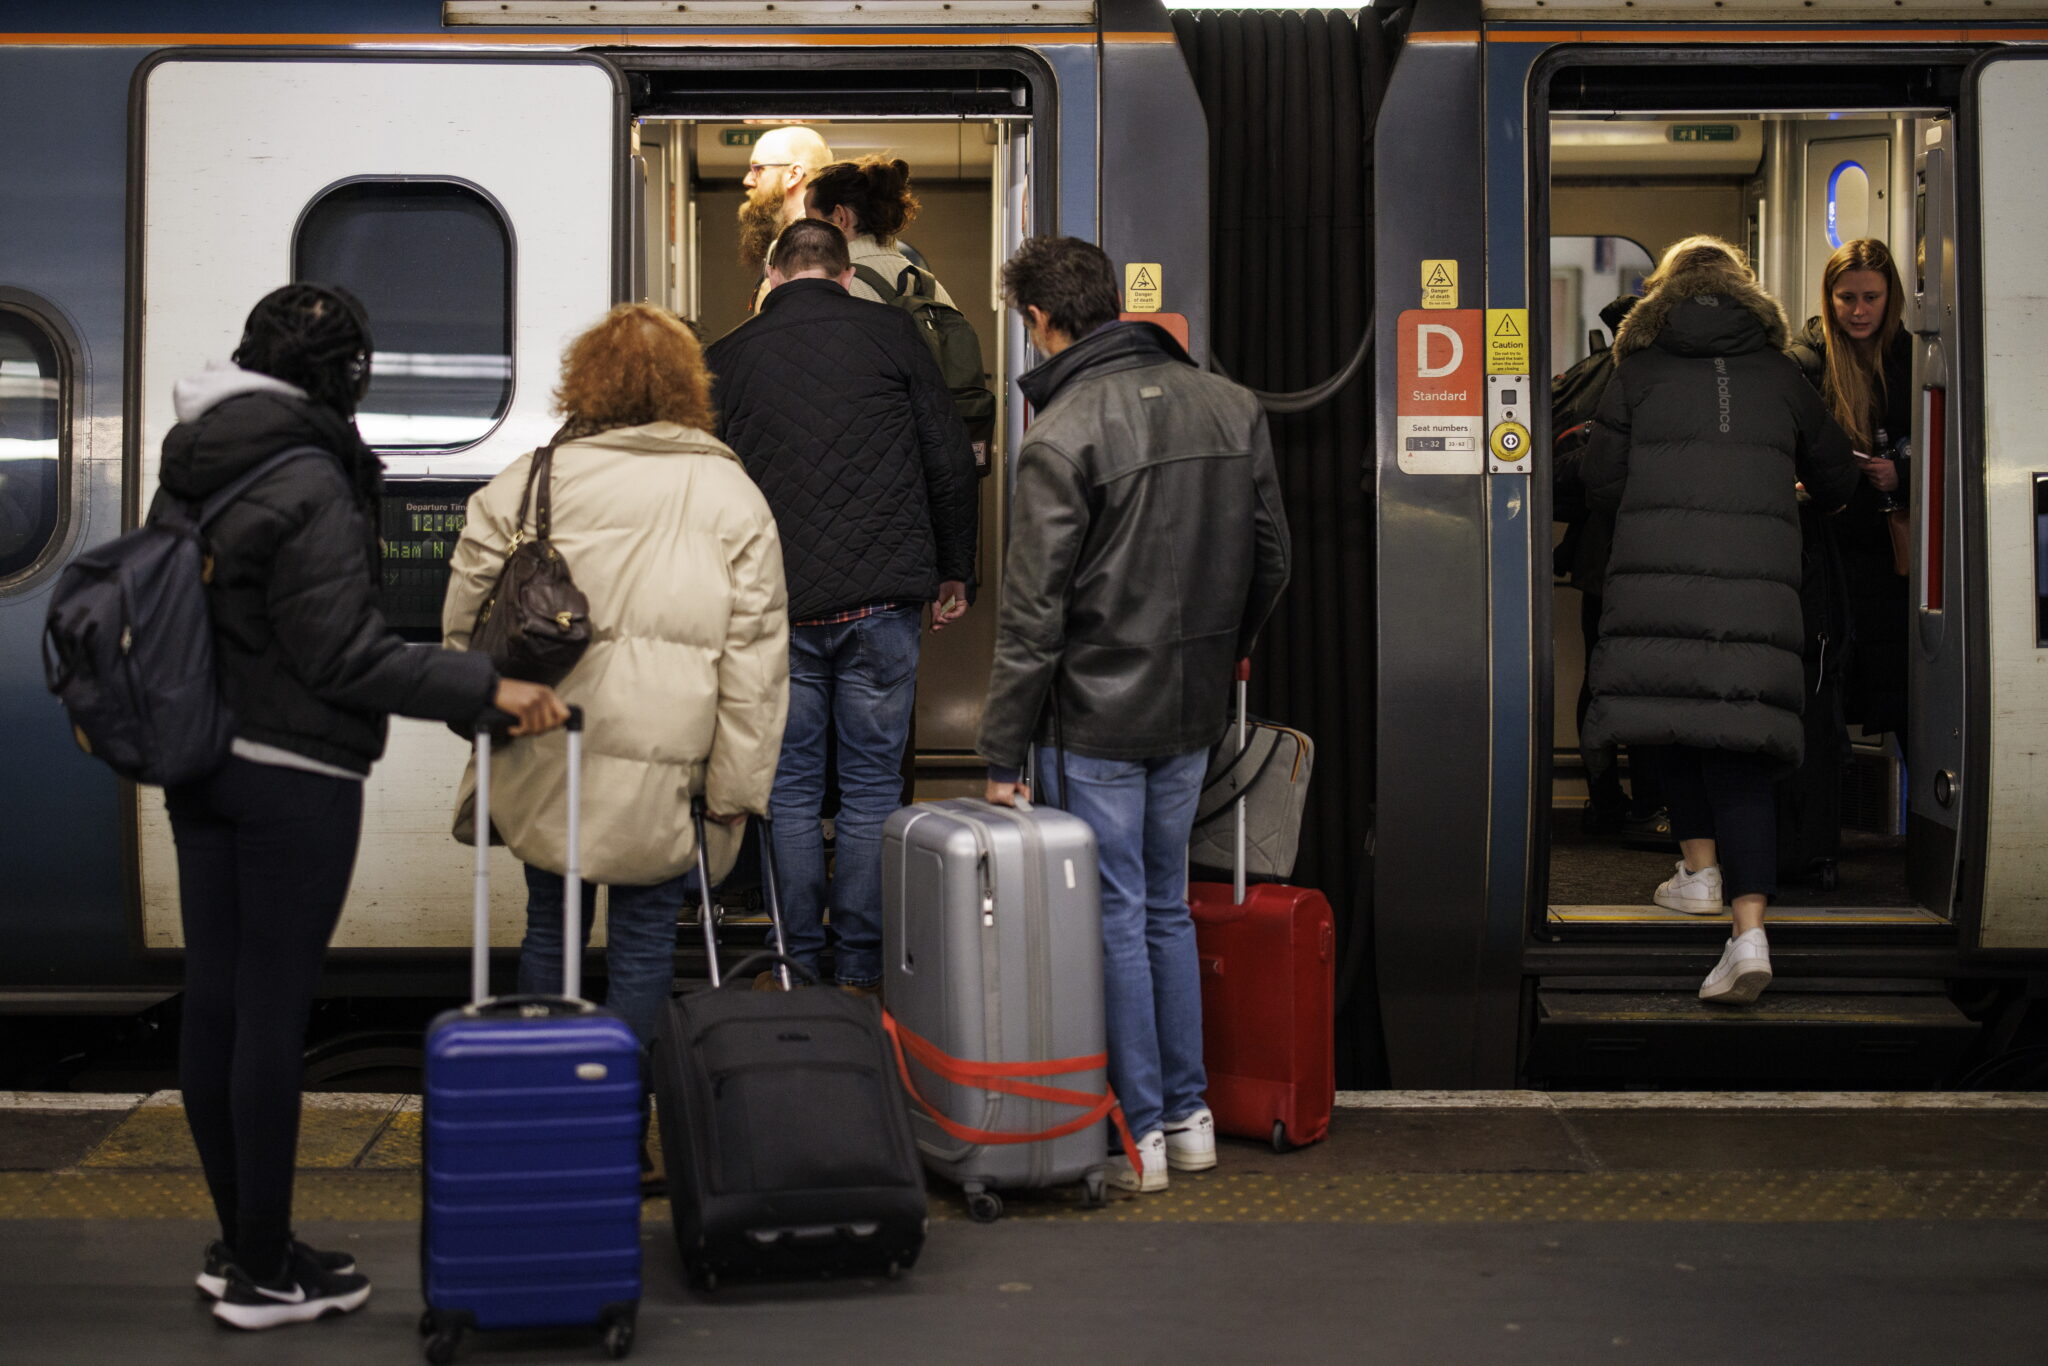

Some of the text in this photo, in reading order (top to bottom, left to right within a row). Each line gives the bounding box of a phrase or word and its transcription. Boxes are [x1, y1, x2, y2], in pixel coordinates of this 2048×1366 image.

[1417, 324, 1464, 378] D
[1492, 340, 1524, 349] Caution
[1413, 390, 1466, 401] Standard
[1714, 357, 1732, 433] ew balance
[406, 503, 448, 512] Departure
[433, 541, 444, 558] N
